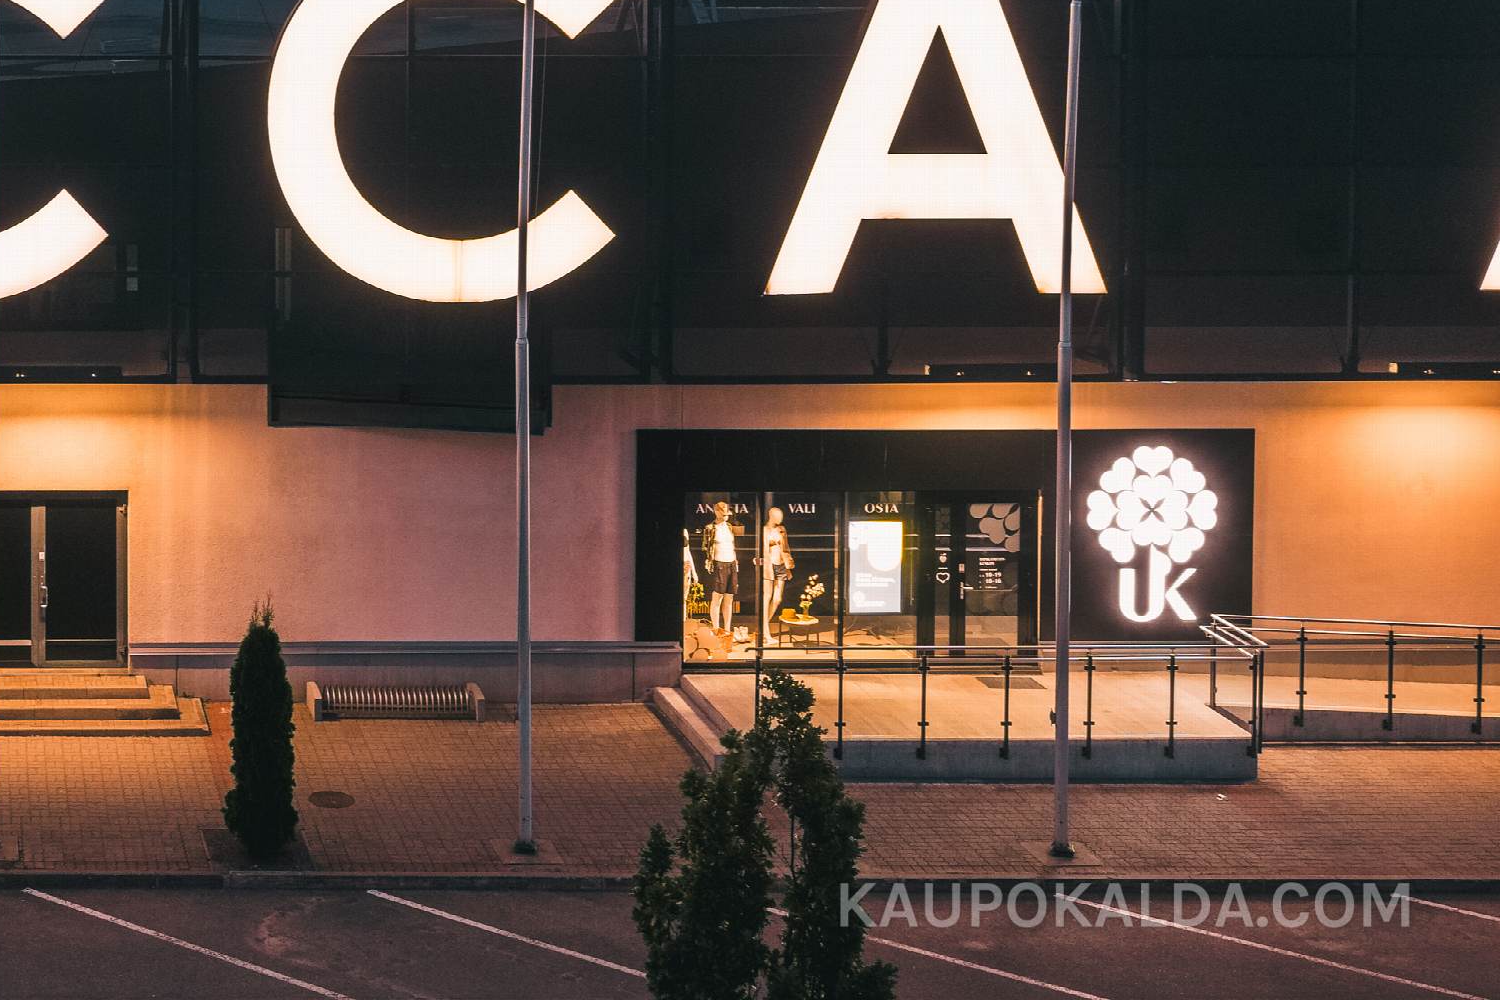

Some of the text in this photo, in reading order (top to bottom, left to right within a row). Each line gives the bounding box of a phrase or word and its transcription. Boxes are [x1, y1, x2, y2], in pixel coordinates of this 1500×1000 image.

[695, 503, 899, 514] ANTA VALI OSTA
[1119, 552, 1198, 623] UK
